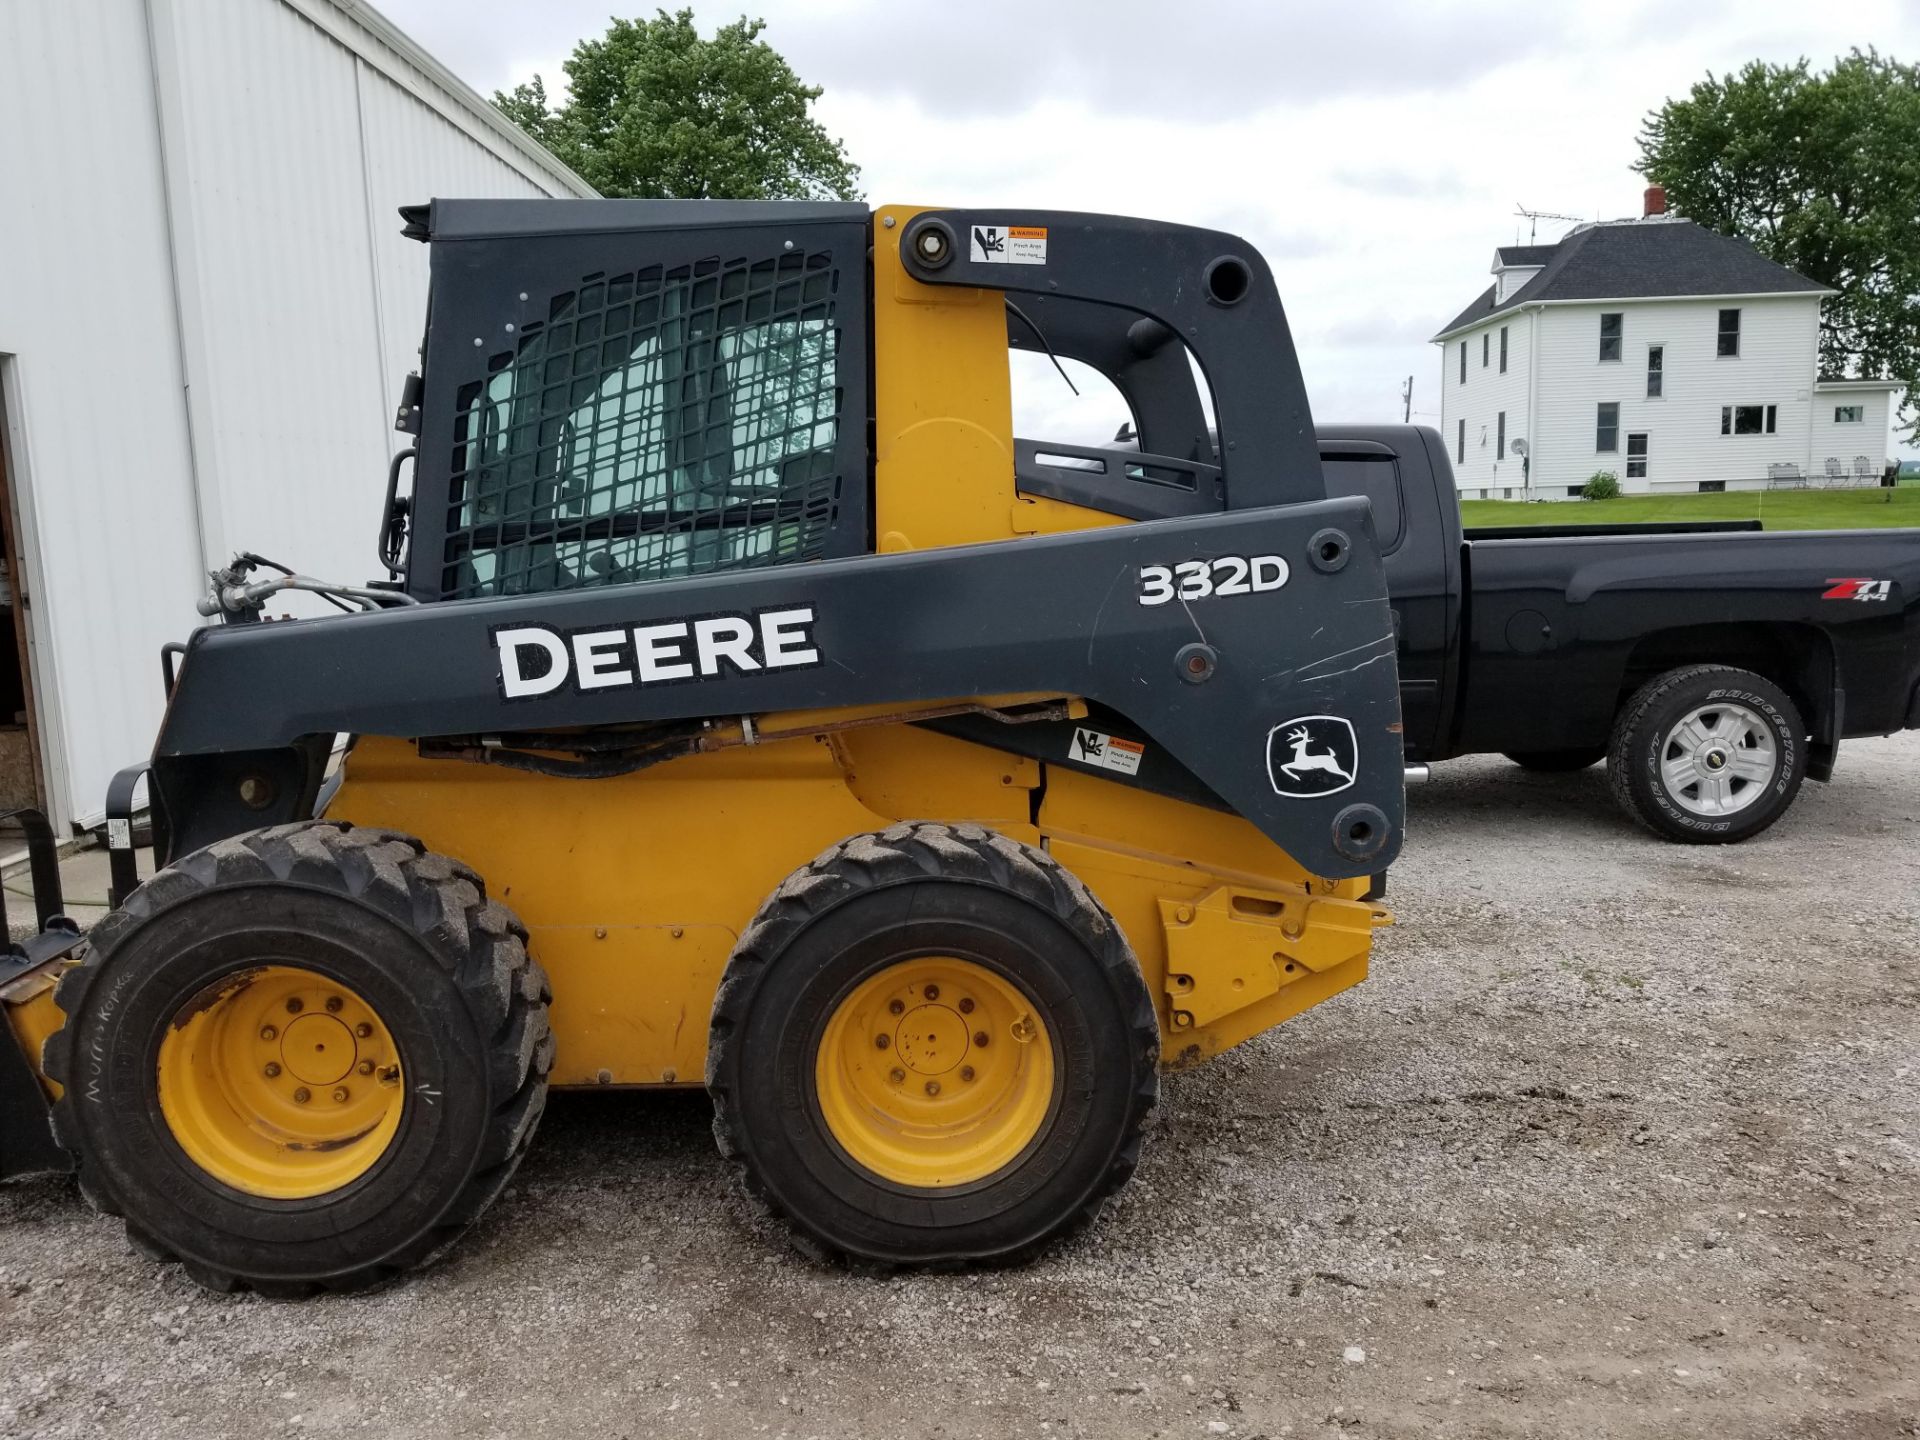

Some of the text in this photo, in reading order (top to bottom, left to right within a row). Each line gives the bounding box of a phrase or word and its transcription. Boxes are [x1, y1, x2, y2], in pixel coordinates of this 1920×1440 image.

[1139, 555, 1290, 605] 332D
[1822, 578, 1892, 599] Z71
[496, 608, 818, 698] DEERE
[1706, 689, 1794, 794] BRIDGESTONE
